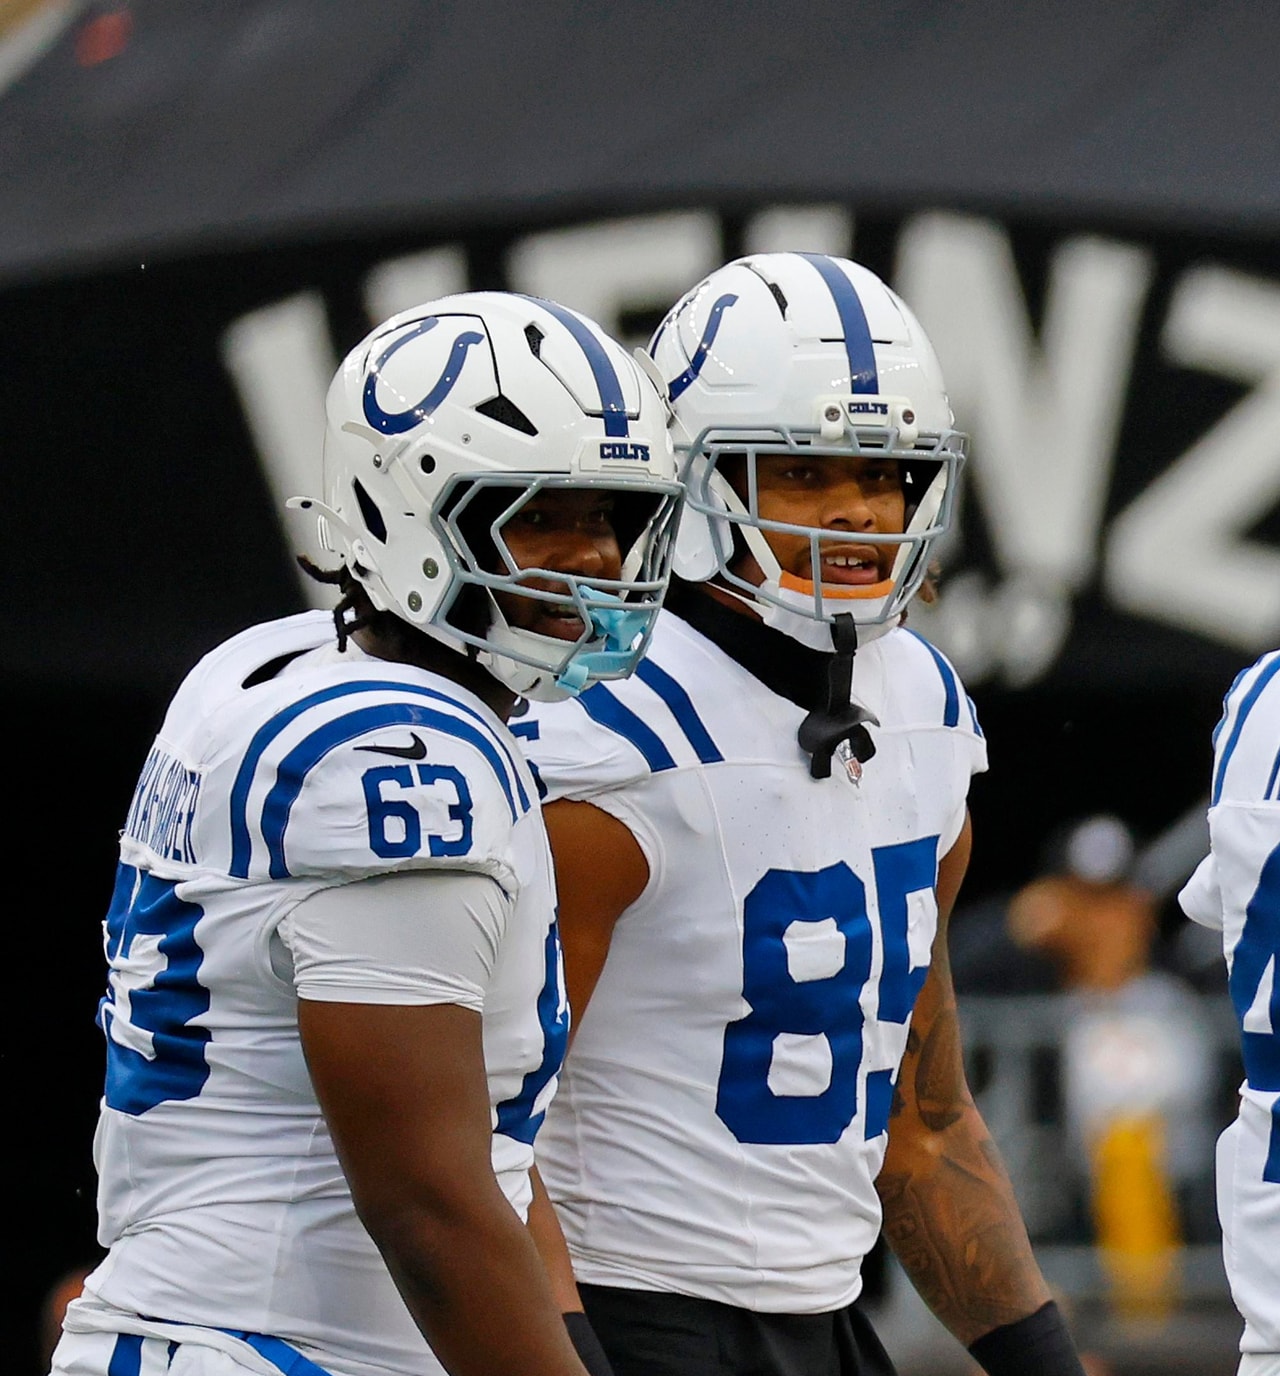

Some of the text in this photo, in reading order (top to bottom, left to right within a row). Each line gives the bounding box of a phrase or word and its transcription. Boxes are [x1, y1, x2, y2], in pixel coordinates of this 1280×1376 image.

[849, 402, 888, 415] COLTS
[599, 443, 651, 462] COLTS
[360, 764, 474, 858] 63
[714, 834, 941, 1146] 85
